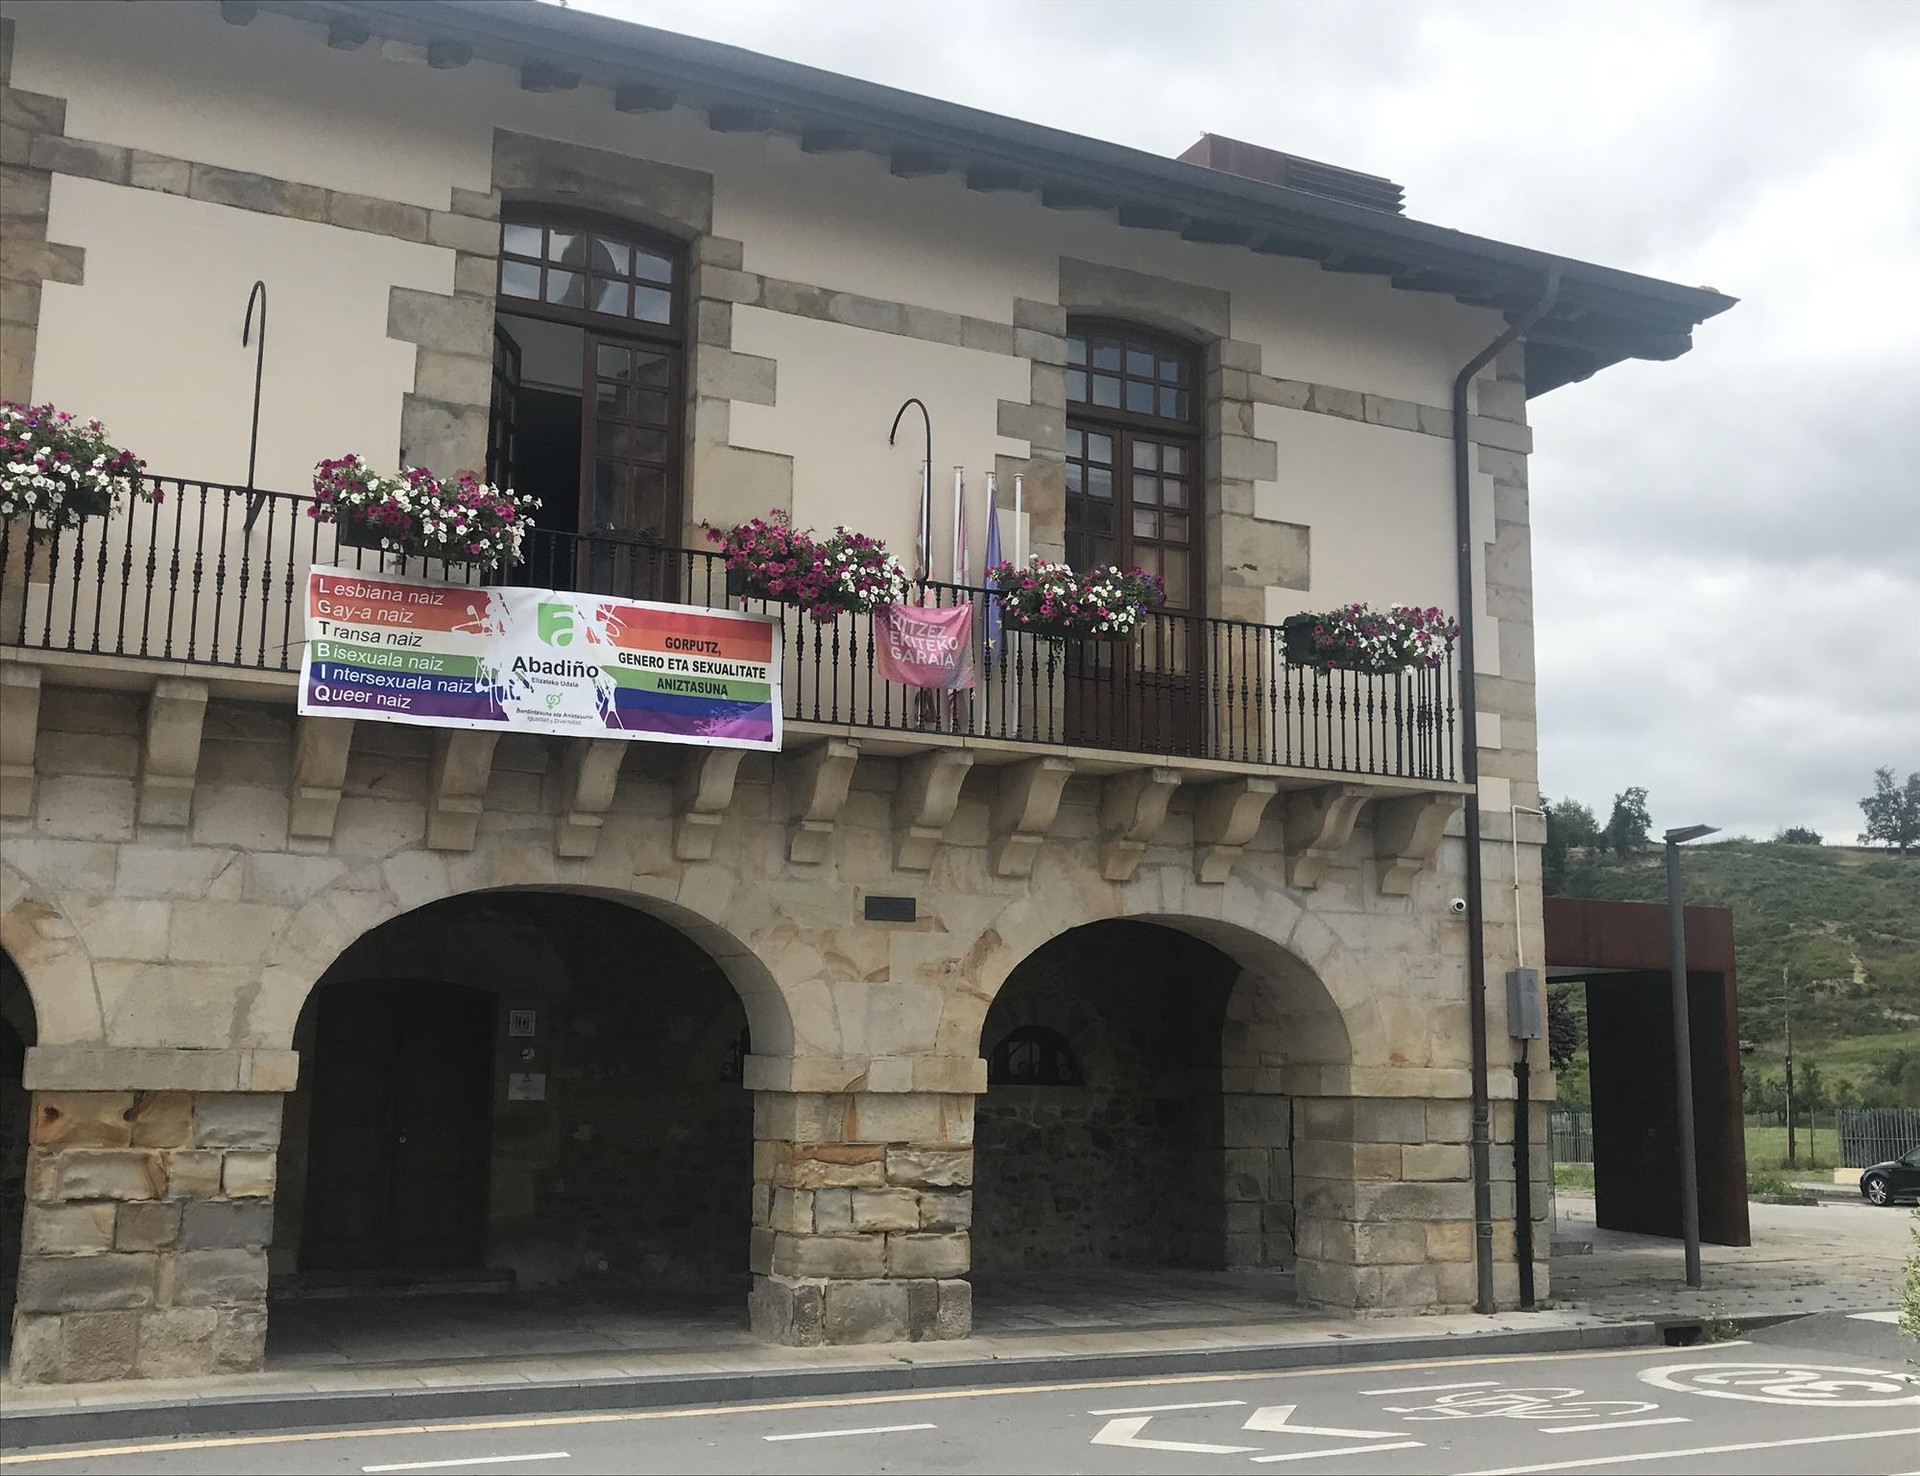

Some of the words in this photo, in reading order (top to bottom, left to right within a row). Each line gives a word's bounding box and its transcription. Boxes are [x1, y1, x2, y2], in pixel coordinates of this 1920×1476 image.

[319, 578, 403, 602] Lesbiana
[408, 589, 444, 606] naiz
[317, 600, 372, 620] Gay-a
[377, 606, 414, 624] naiz
[318, 621, 380, 643] Transa
[386, 631, 423, 647] naiz
[665, 636, 722, 656] GORPUTZ,
[890, 630, 959, 652] EKITEKO
[317, 643, 403, 668] Bisexuala
[408, 655, 444, 671] naiz
[511, 656, 599, 679] Abadiño
[618, 652, 665, 669] GENERO
[667, 658, 689, 672] ETA
[692, 660, 766, 679] SEXUALITATE
[890, 646, 955, 667] GARAIA
[320, 664, 431, 691] Intersexuala
[437, 678, 473, 694] naiz
[531, 677, 559, 686] Elizateko
[656, 677, 728, 696] ANIZTASUNA
[314, 685, 372, 704] Queer
[377, 693, 412, 709] naiz
